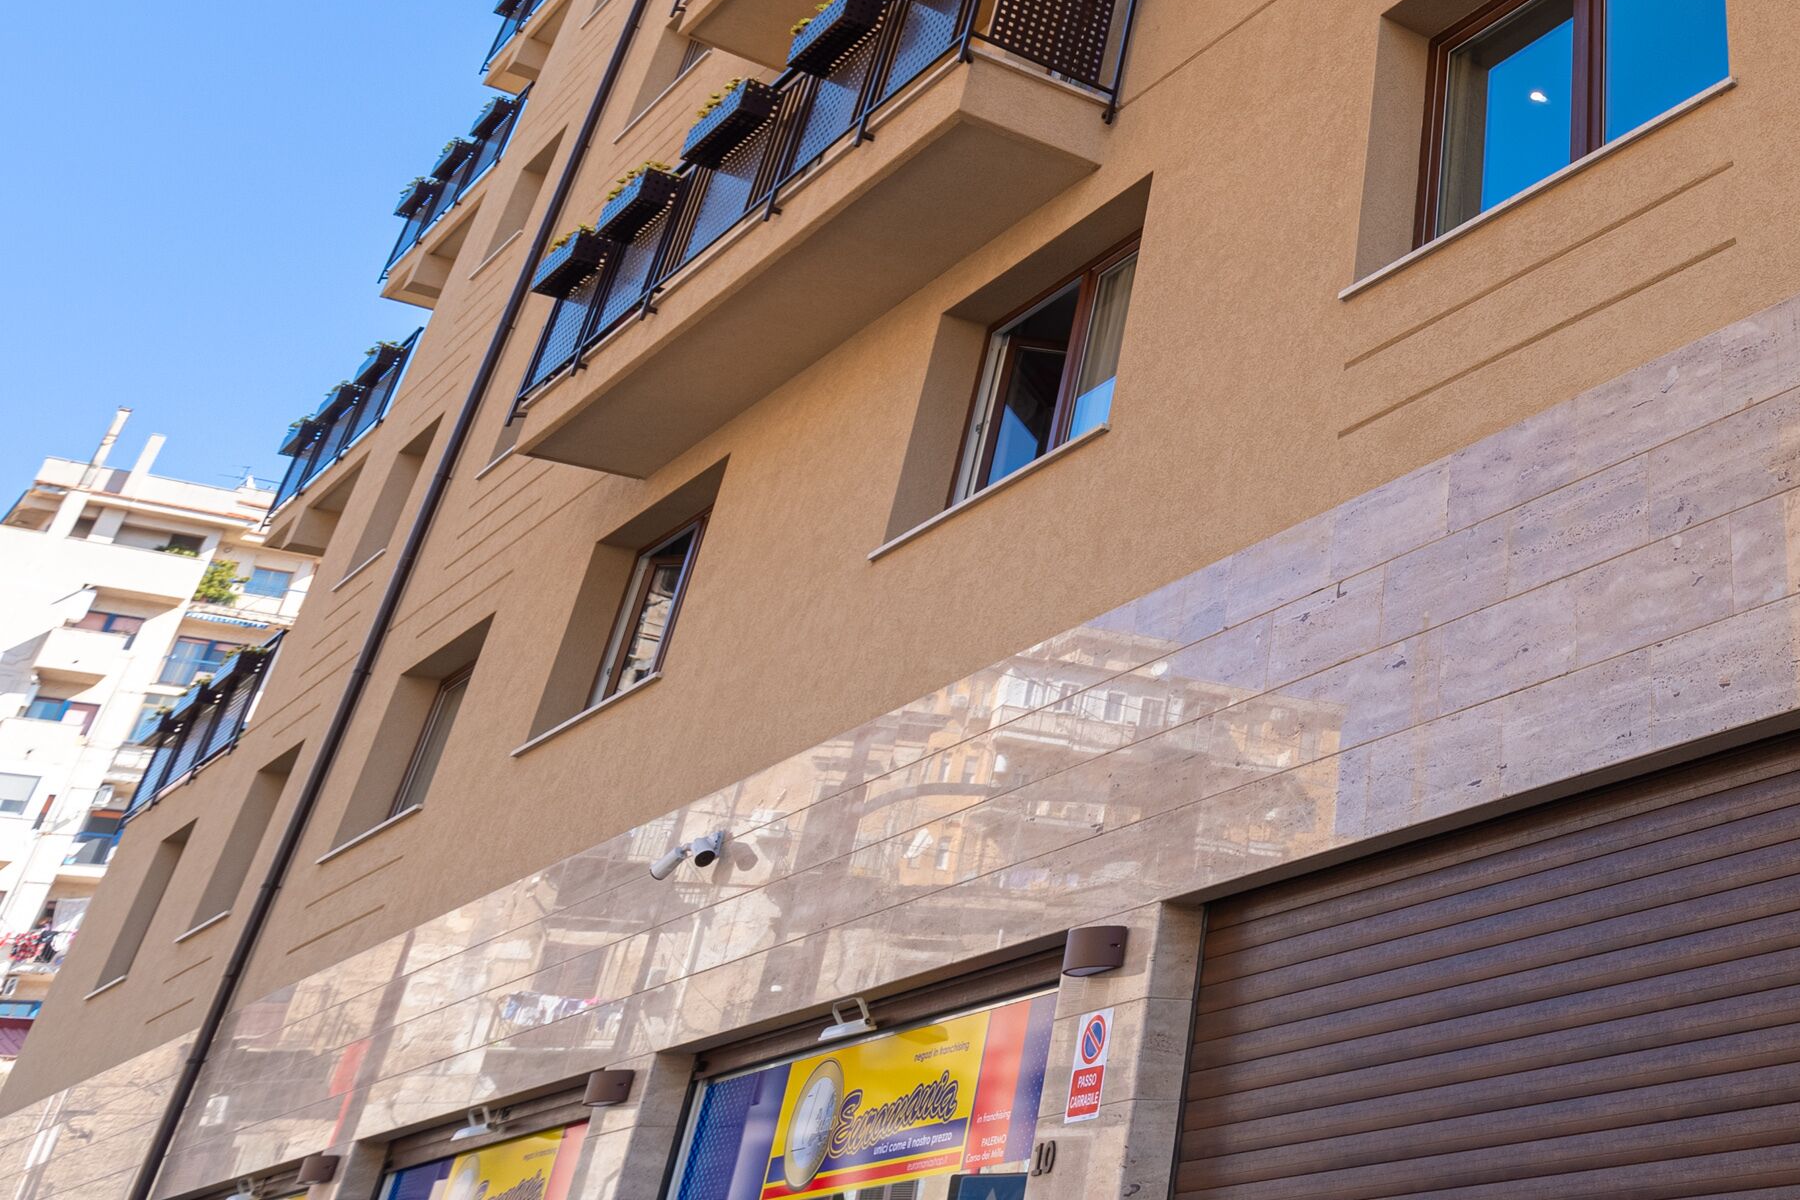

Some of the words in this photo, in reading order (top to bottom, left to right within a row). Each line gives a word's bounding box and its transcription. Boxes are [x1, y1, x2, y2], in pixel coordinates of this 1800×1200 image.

[939, 1041, 970, 1055] franchising
[1077, 1073, 1097, 1088] PASSO
[1070, 1092, 1099, 1108] CARRABILE
[829, 1069, 958, 1159] Euromania
[983, 1110, 1012, 1122] franchising
[873, 1142, 888, 1155] unici
[888, 1141, 907, 1153] come
[911, 1135, 931, 1147] nostro
[930, 1131, 953, 1146] prezzo
[981, 1134, 1007, 1147] PALERMO
[965, 1153, 981, 1164] Corso
[1031, 1140, 1057, 1177] 10
